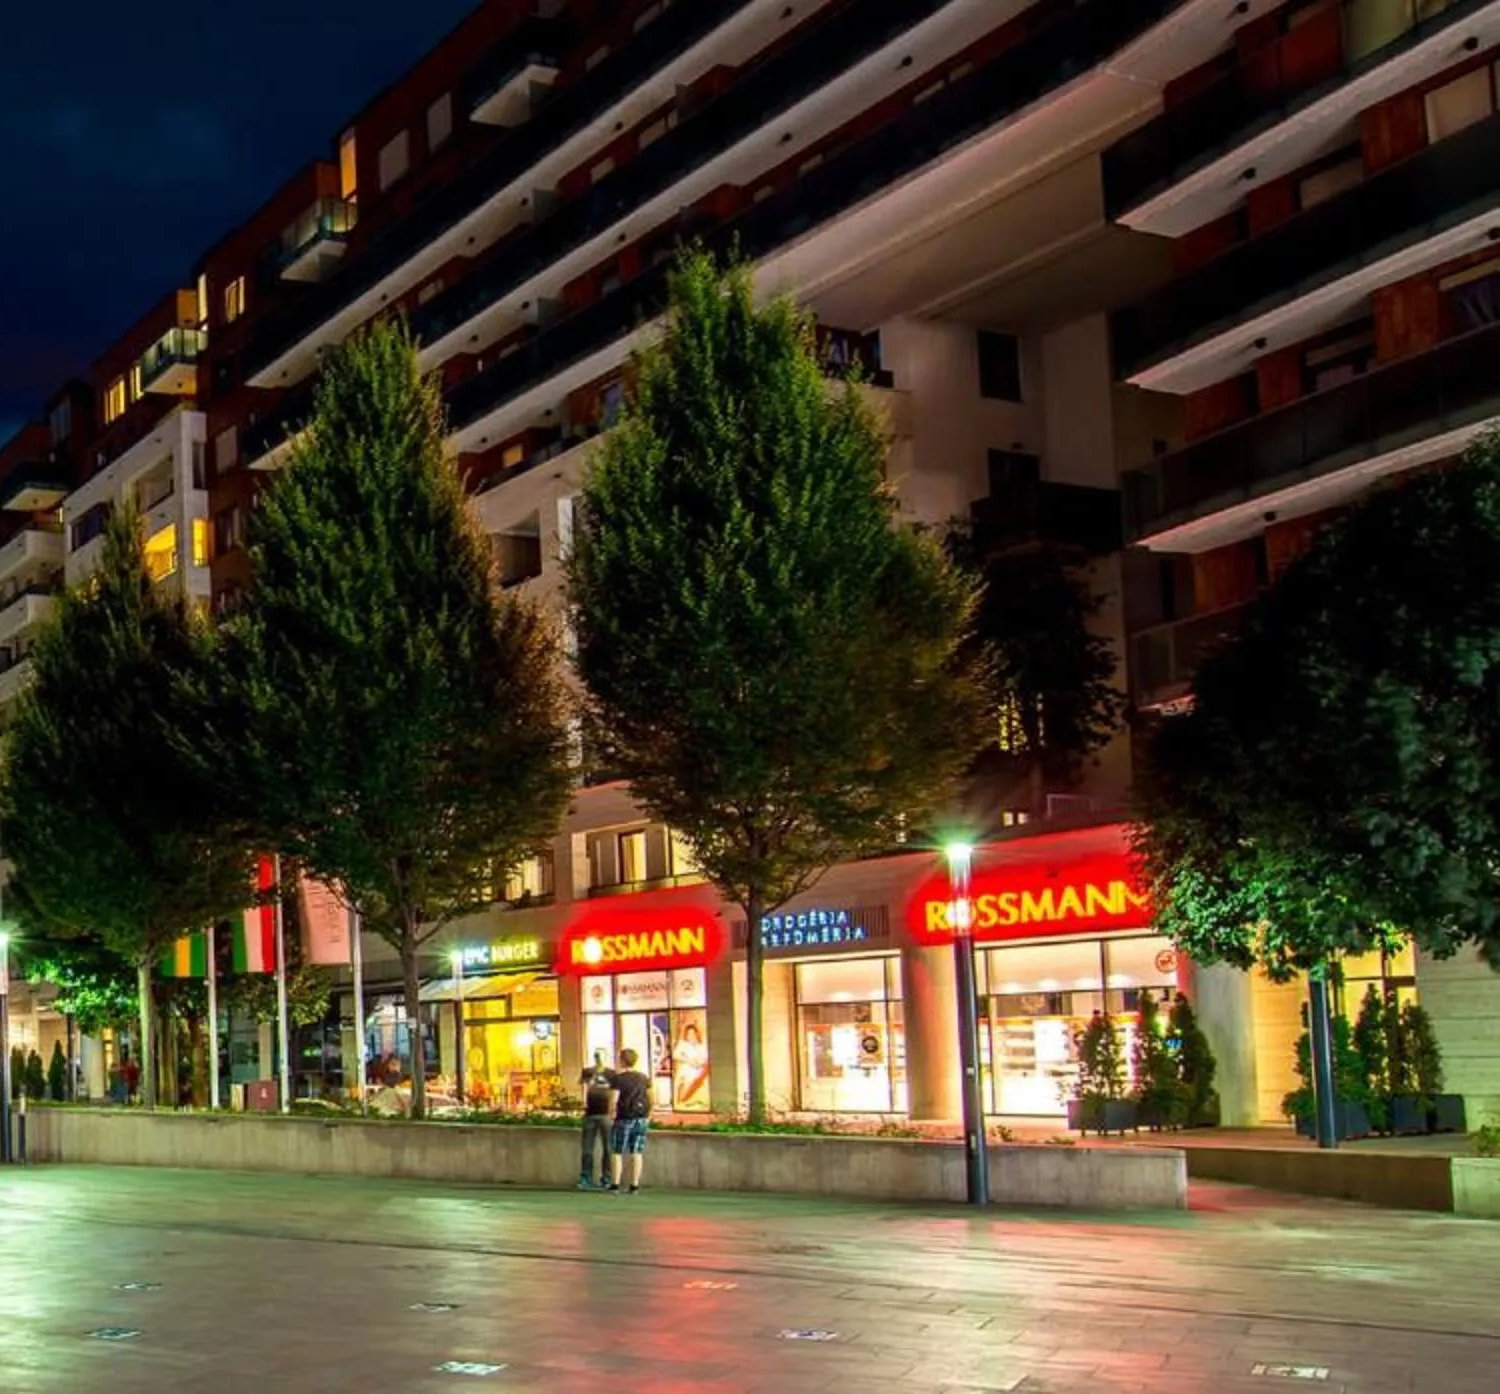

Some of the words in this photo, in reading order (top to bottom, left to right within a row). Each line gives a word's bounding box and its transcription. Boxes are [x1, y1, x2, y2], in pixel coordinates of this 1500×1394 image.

[761, 910, 847, 932] DROGÉRIA
[491, 941, 538, 962] BURGER
[571, 927, 705, 964] ROSSMANN
